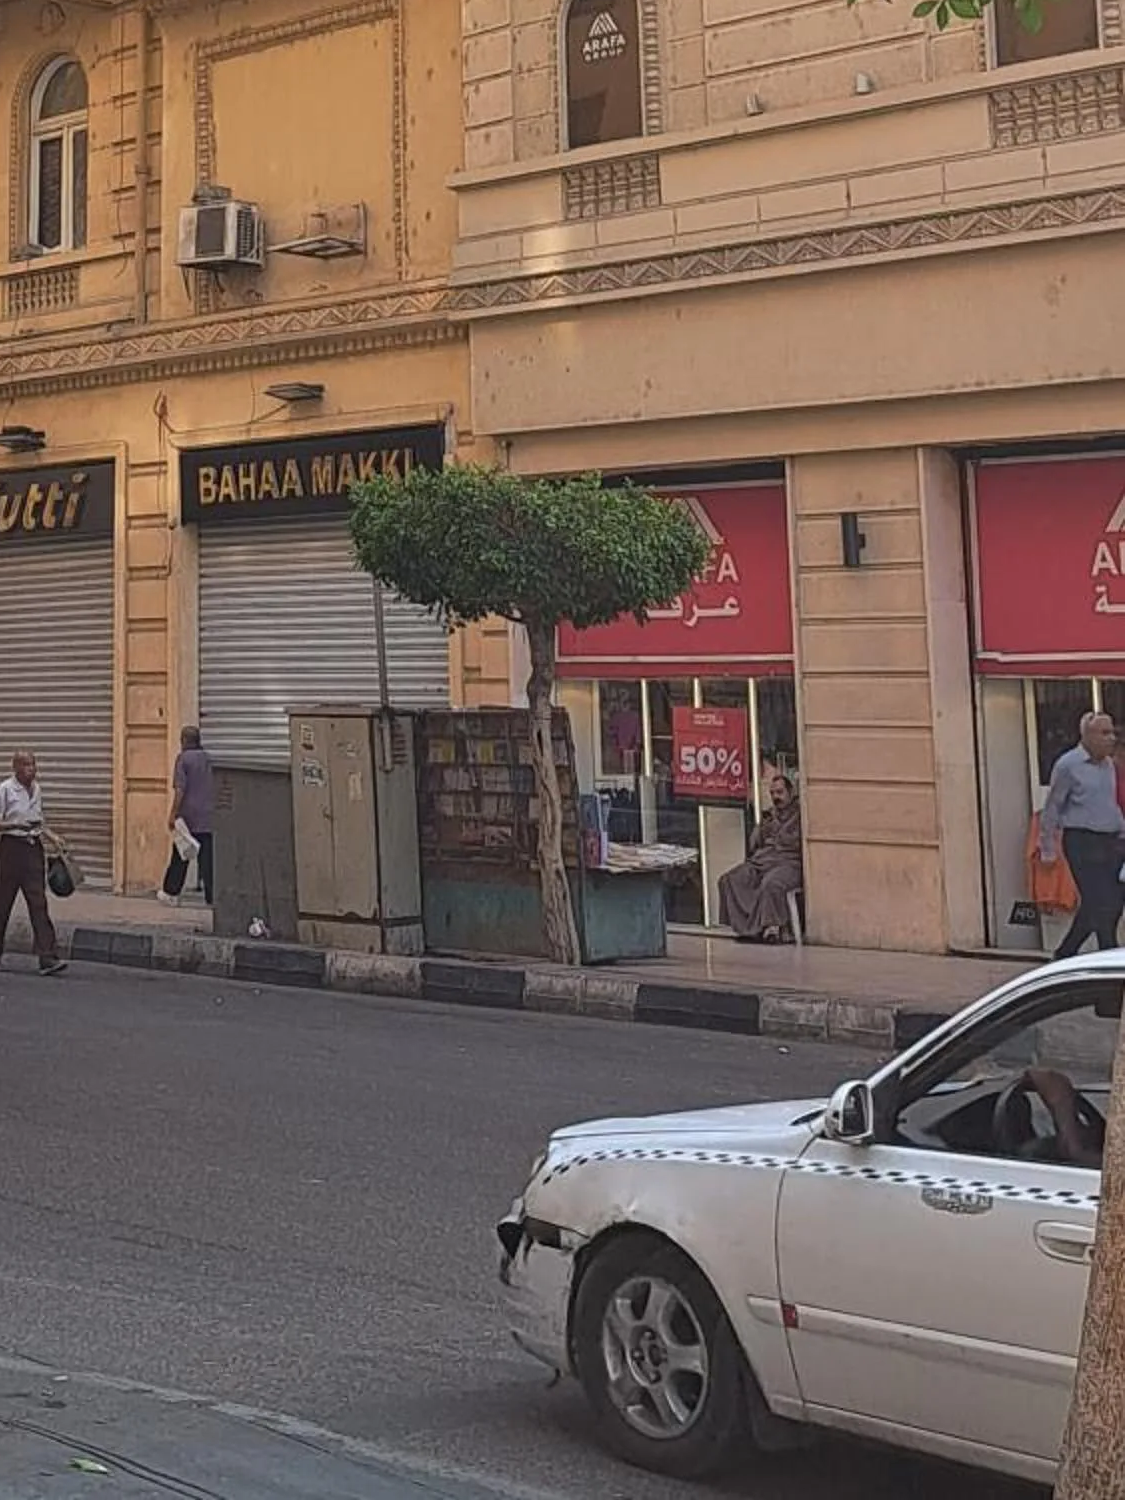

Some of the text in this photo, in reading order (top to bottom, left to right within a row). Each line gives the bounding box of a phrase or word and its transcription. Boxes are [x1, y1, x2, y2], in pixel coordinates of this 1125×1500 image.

[583, 34, 626, 53] ARAFA
[198, 457, 305, 505] BAHAA
[679, 746, 743, 777] 50%
